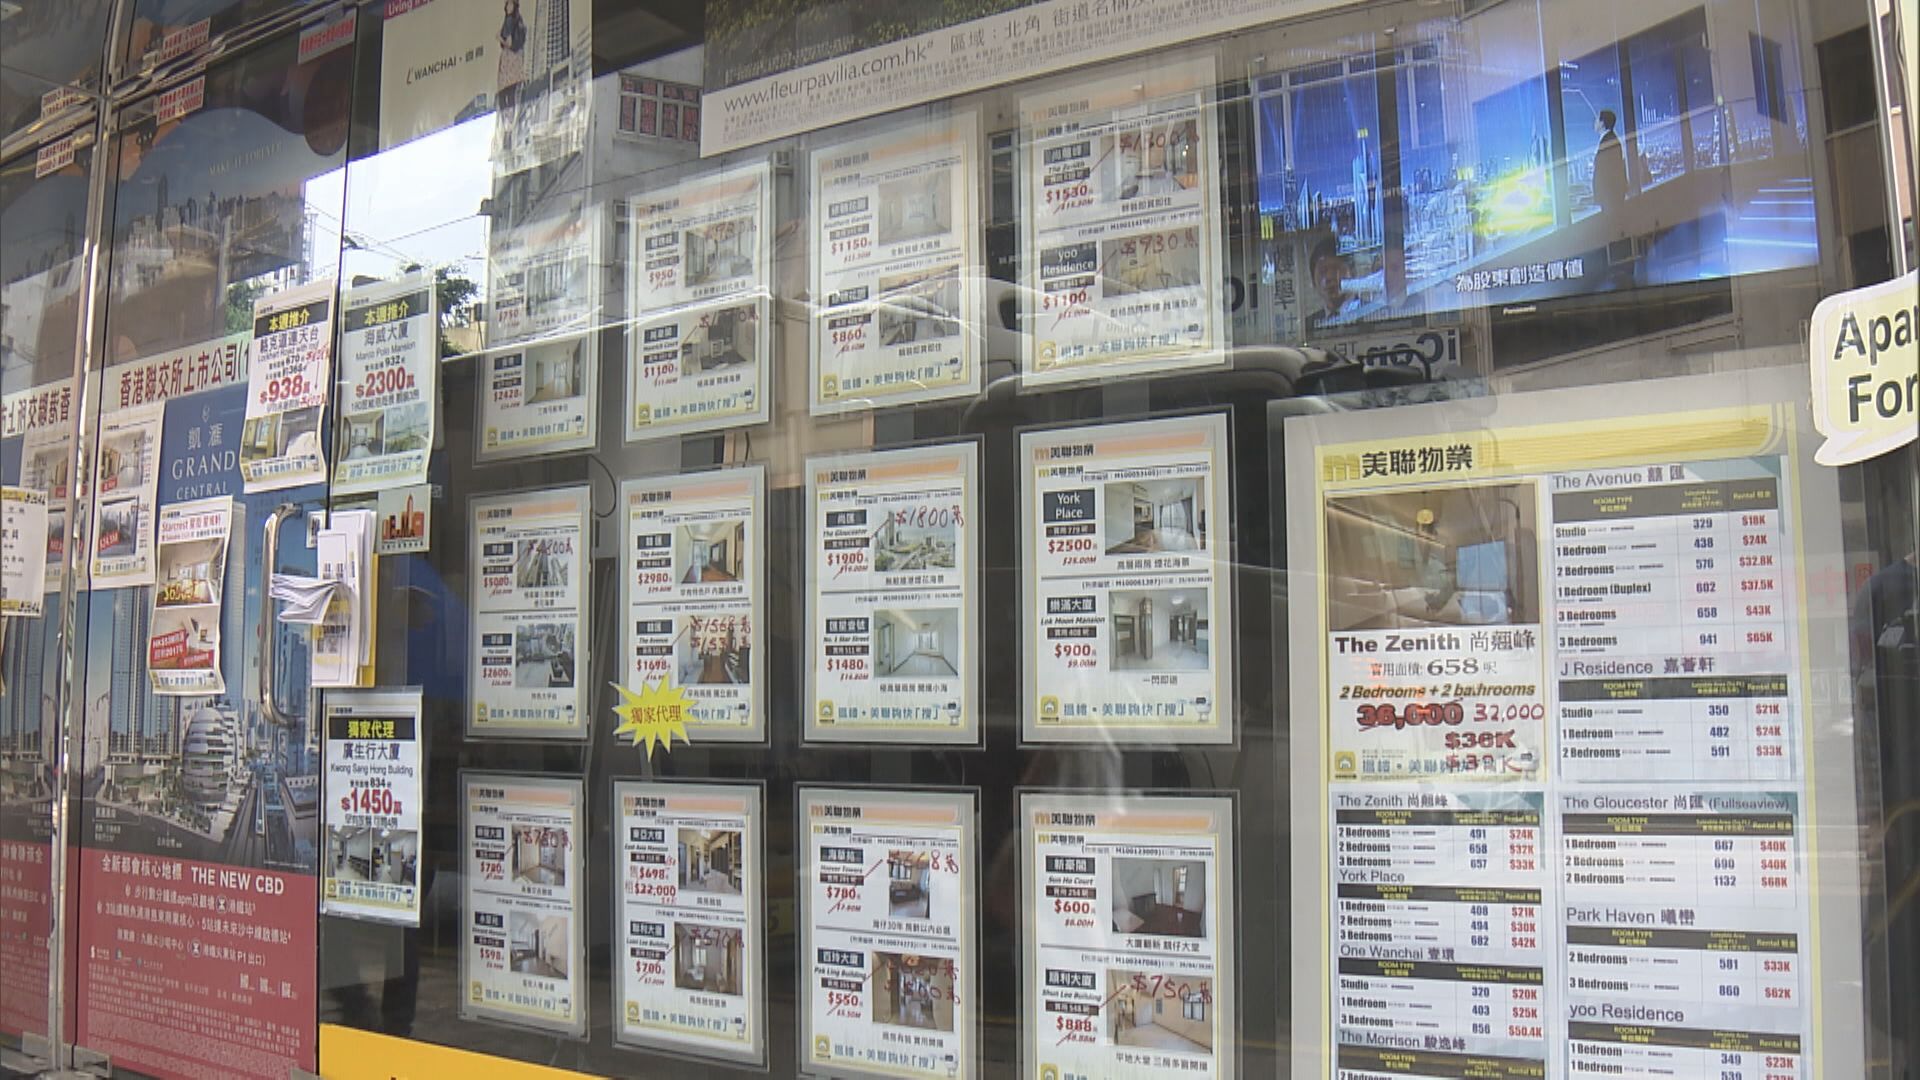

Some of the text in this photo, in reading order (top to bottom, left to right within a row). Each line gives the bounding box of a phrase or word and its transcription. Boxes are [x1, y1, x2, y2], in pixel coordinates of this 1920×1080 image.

[415, 57, 456, 80] WANCHAI
[1058, 249, 1077, 262] yoo
[1043, 261, 1094, 276] Residence
[1455, 257, 1584, 293] 為股東創造價值
[269, 307, 310, 331] 本週推介
[365, 300, 409, 326] 本週推介
[385, 355, 400, 367] 932
[172, 450, 235, 481] GRAND
[1362, 444, 1472, 478] 美聯物業
[1553, 475, 1581, 489] The
[1585, 472, 1642, 487] Avenue
[176, 481, 228, 500] CENTRAL
[1057, 493, 1081, 504] York
[1055, 508, 1083, 519] Place
[1556, 515, 1765, 538] Studio 329 $18K
[1557, 535, 1767, 557] 1 Bedroom 438 $24K
[1557, 555, 1772, 577] 2 Bedrooms 576 $32.8K
[1558, 579, 1773, 597] 1 Bedroom (Duplex) 602 $37.5K
[1075, 616, 1105, 624] Mansion
[1559, 605, 1771, 621] 3 Bedrooms 658 $43K
[1335, 630, 1535, 654] The Zenith 尚翹峰
[1560, 631, 1773, 646] 3 Bedrooms 941 $65K
[1427, 659, 1479, 676] 658
[1560, 663, 1569, 676] J
[1574, 661, 1653, 675] Residence
[1340, 683, 1535, 699] 2 Bedrooms + 2 bathrooms
[631, 705, 682, 724] 獨家代理
[1474, 704, 1544, 723] 32,000
[348, 720, 395, 739] 獨家代理
[343, 742, 400, 761] 廣生行大廈
[331, 763, 413, 777] Kwong Sang Hong Building
[370, 777, 386, 788] 834
[1338, 793, 1448, 807] The Zenith 尚翹峰
[1563, 797, 1589, 808] The
[1593, 797, 1668, 810] Gloucester
[1708, 797, 1789, 811] (Fullseaview)
[102, 854, 284, 895] 全新都會核心地標 THE NEW CBD
[1048, 876, 1061, 884] Sun
[1074, 877, 1093, 885] Court
[1340, 870, 1405, 883] York Place
[1567, 907, 1600, 922] Park
[1606, 909, 1655, 924] Haven
[1340, 945, 1366, 957] One
[1369, 946, 1423, 960] Wanchai
[829, 969, 840, 977] Ling
[842, 970, 867, 980] Building
[1042, 989, 1102, 1001] Shun Lee Building
[1570, 1004, 1684, 1022] yoo Residence
[1340, 1030, 1362, 1043] The
[1366, 1033, 1420, 1049] Morrison
